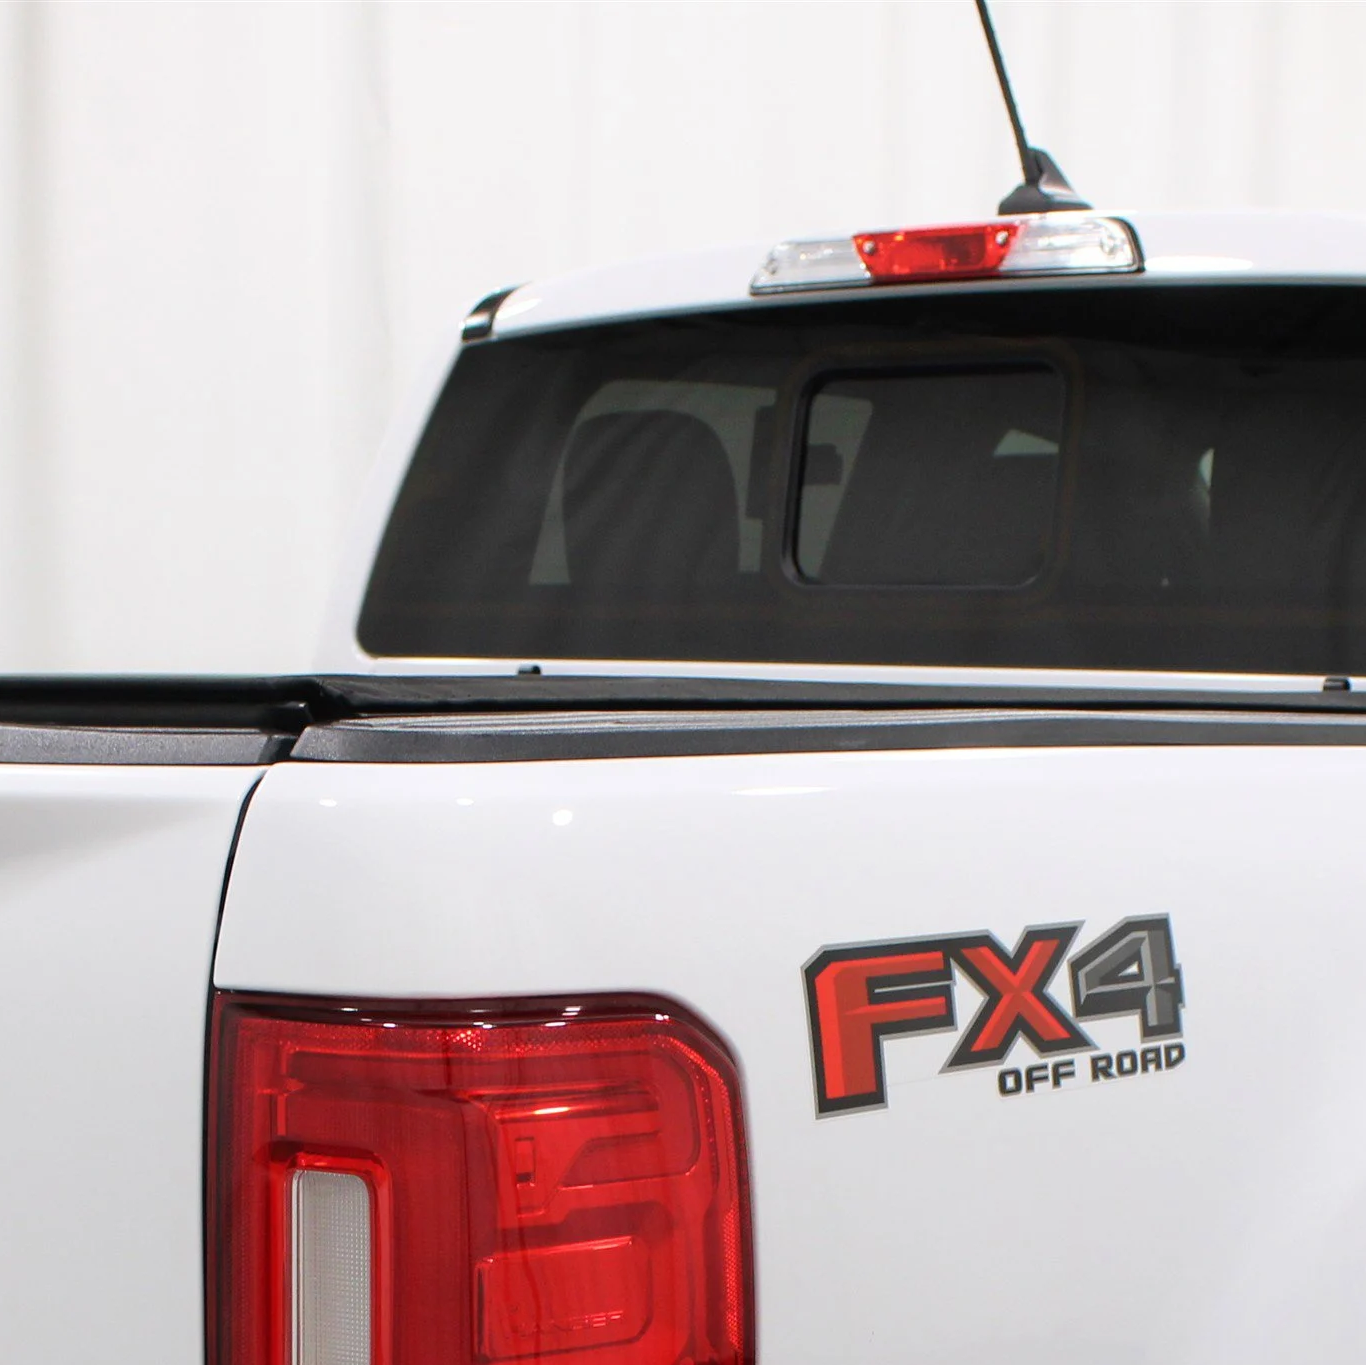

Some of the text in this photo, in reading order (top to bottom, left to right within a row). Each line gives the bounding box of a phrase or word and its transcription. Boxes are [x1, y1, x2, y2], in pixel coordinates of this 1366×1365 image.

[801, 913, 1185, 1119] FX4
[998, 1042, 1186, 1097] OFF ROAD
